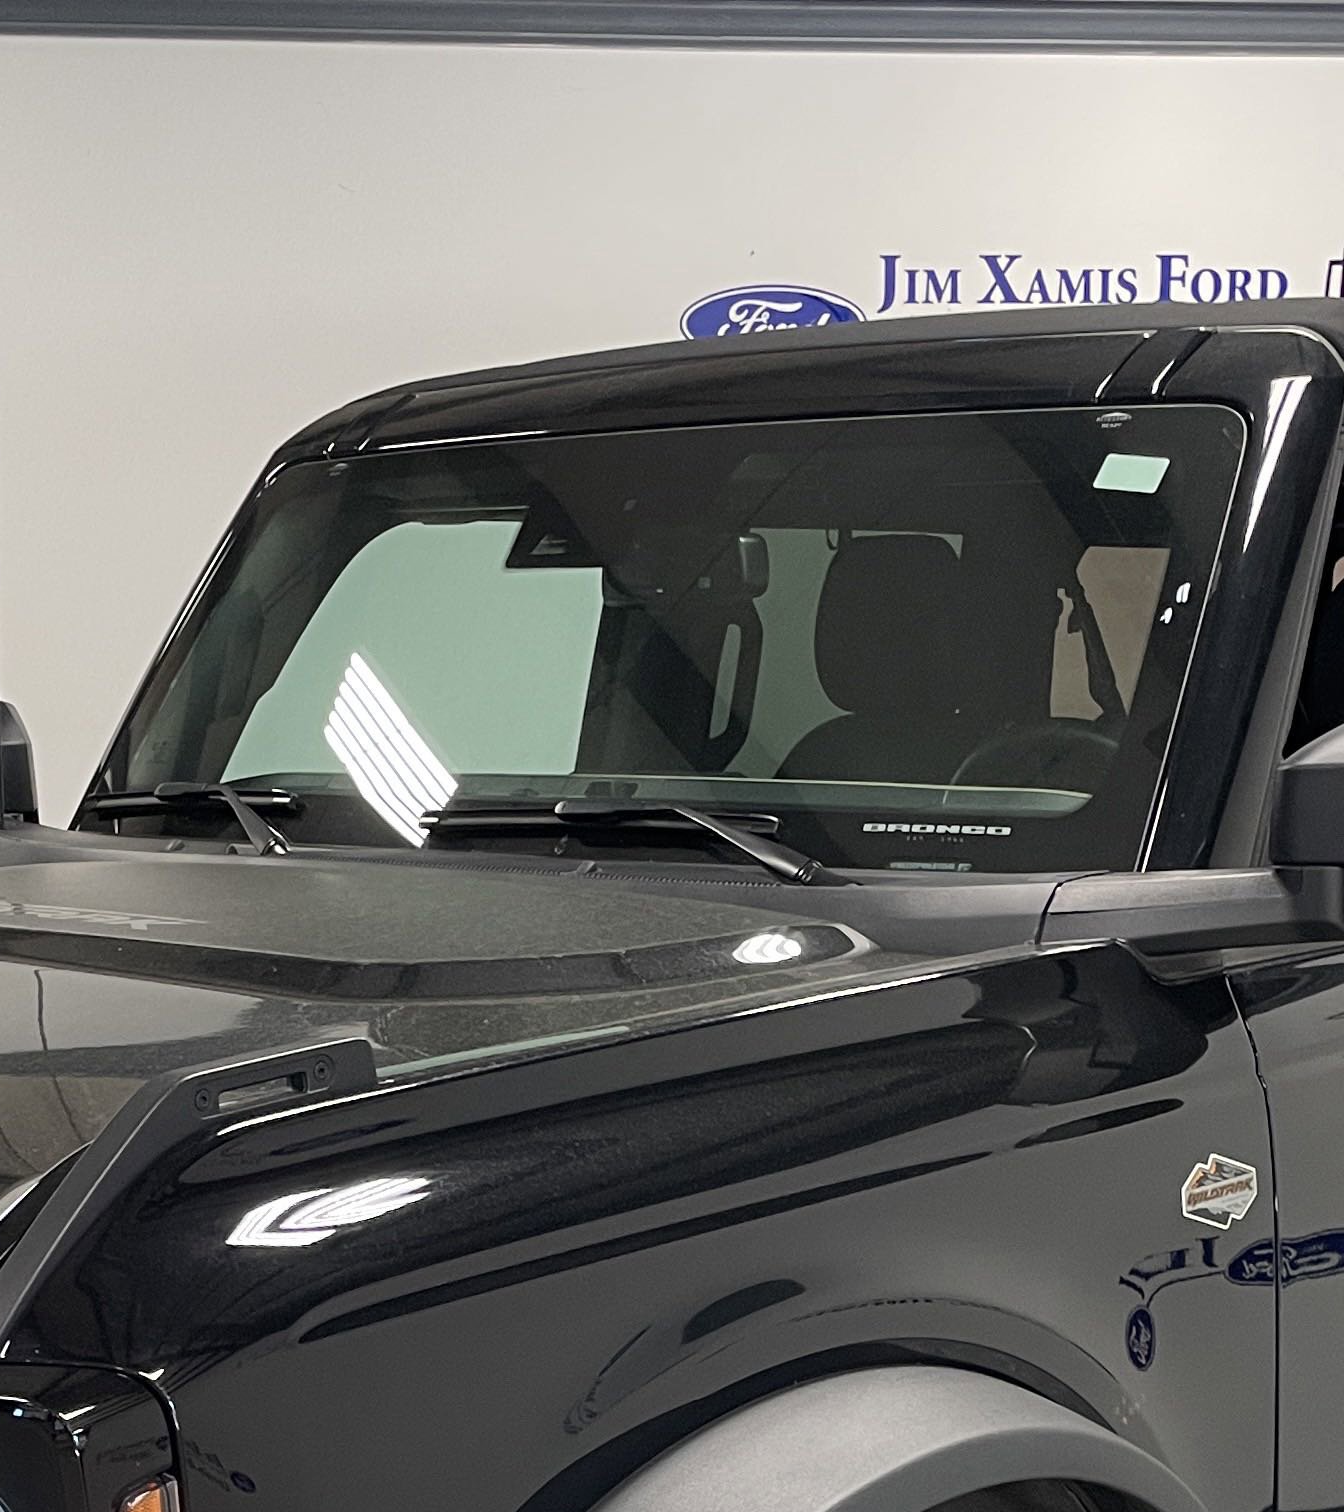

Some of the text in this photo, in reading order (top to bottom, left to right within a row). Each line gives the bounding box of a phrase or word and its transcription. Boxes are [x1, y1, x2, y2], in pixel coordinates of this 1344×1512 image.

[878, 254, 1288, 313] JIM XAMIS FORD
[862, 822, 1011, 836] BRONCO
[1187, 1178, 1253, 1207] WILDTRAK
